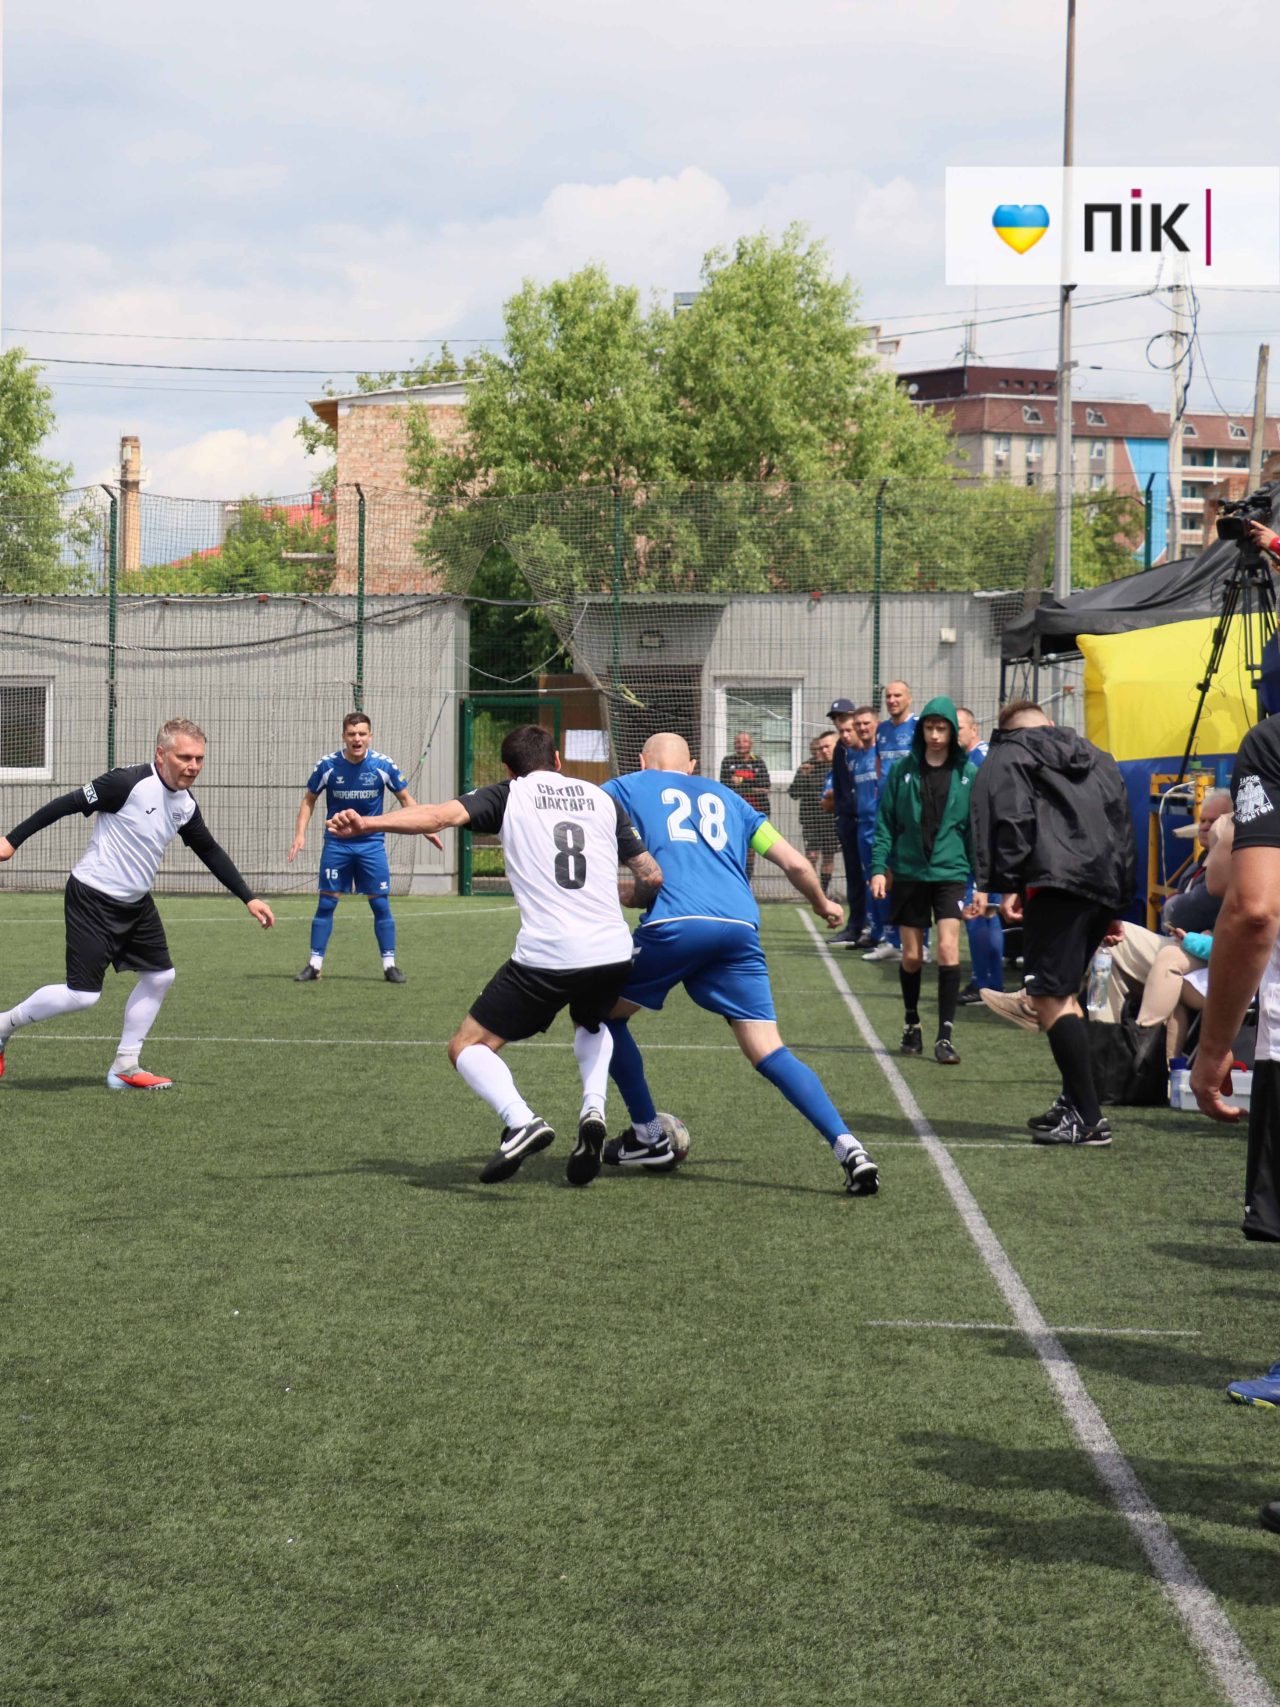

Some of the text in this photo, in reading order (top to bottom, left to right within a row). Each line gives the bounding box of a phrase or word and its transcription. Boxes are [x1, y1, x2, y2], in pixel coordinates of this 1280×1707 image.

[534, 796, 595, 812] ШАХТАРЯ
[661, 788, 728, 851] 28
[325, 868, 339, 880] 15
[552, 821, 587, 890] 8
